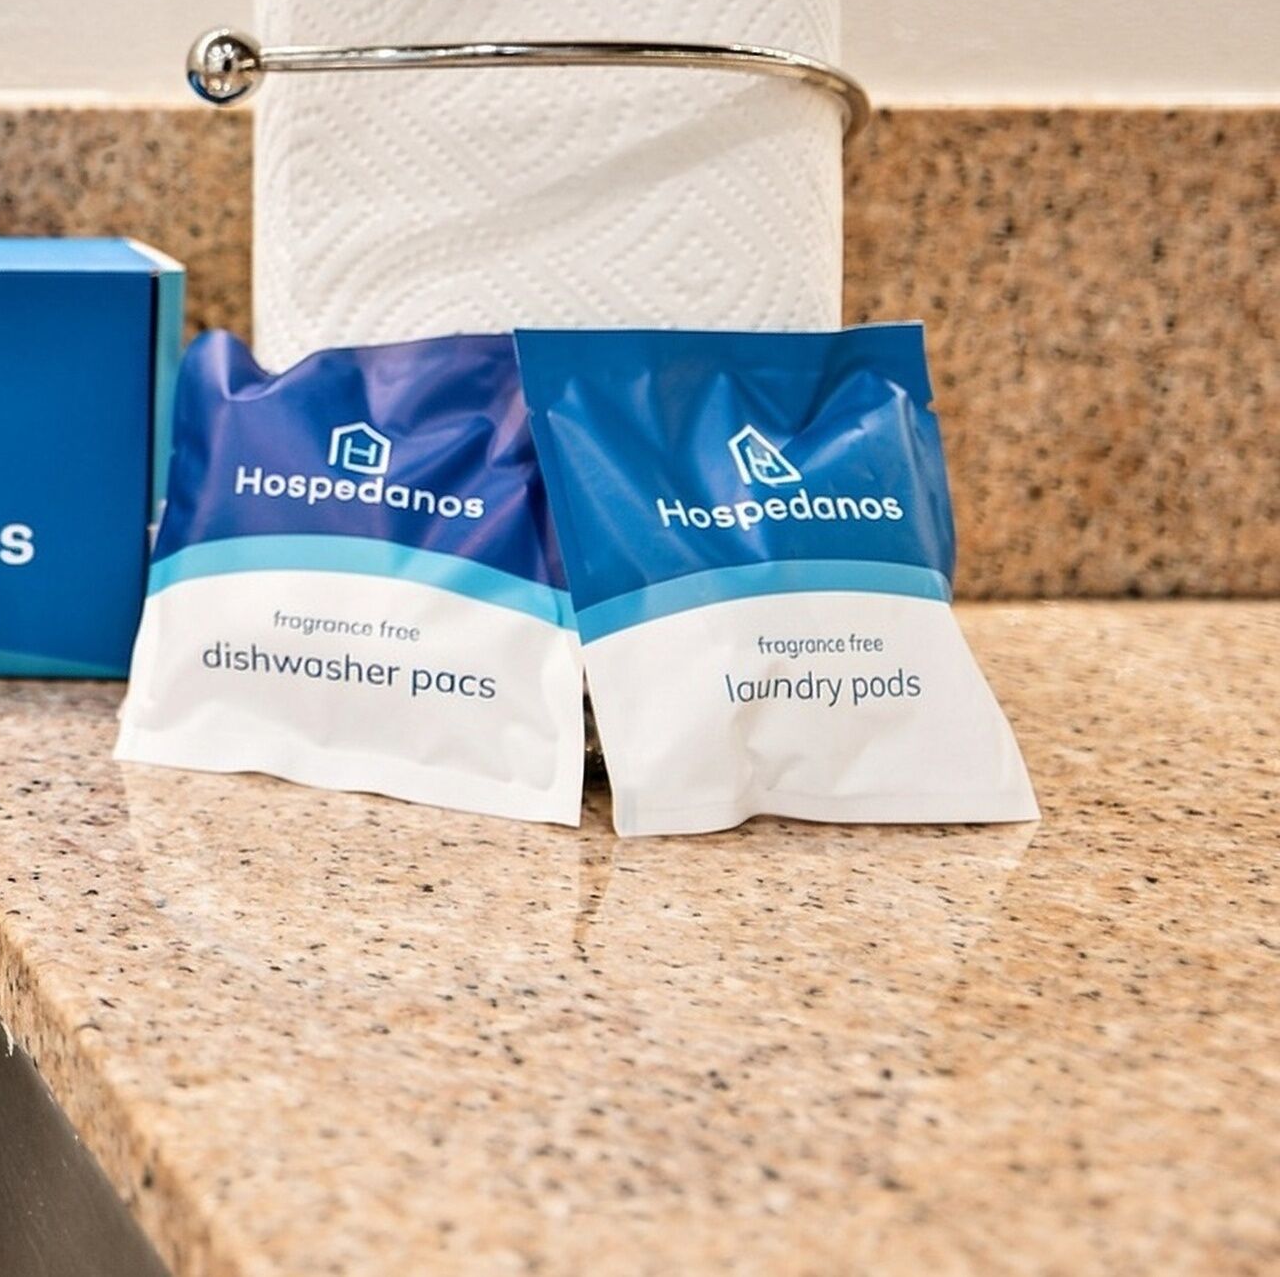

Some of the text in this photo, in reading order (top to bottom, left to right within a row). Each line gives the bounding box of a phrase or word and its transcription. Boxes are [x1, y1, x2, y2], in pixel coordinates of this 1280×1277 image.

[234, 465, 485, 519] Hospedanos
[656, 488, 904, 531] Hospedanos
[273, 610, 421, 642] fragrance free
[757, 633, 884, 659] fragrance free
[202, 641, 497, 700] dishwasher pacs
[725, 667, 922, 708] laundry pods
